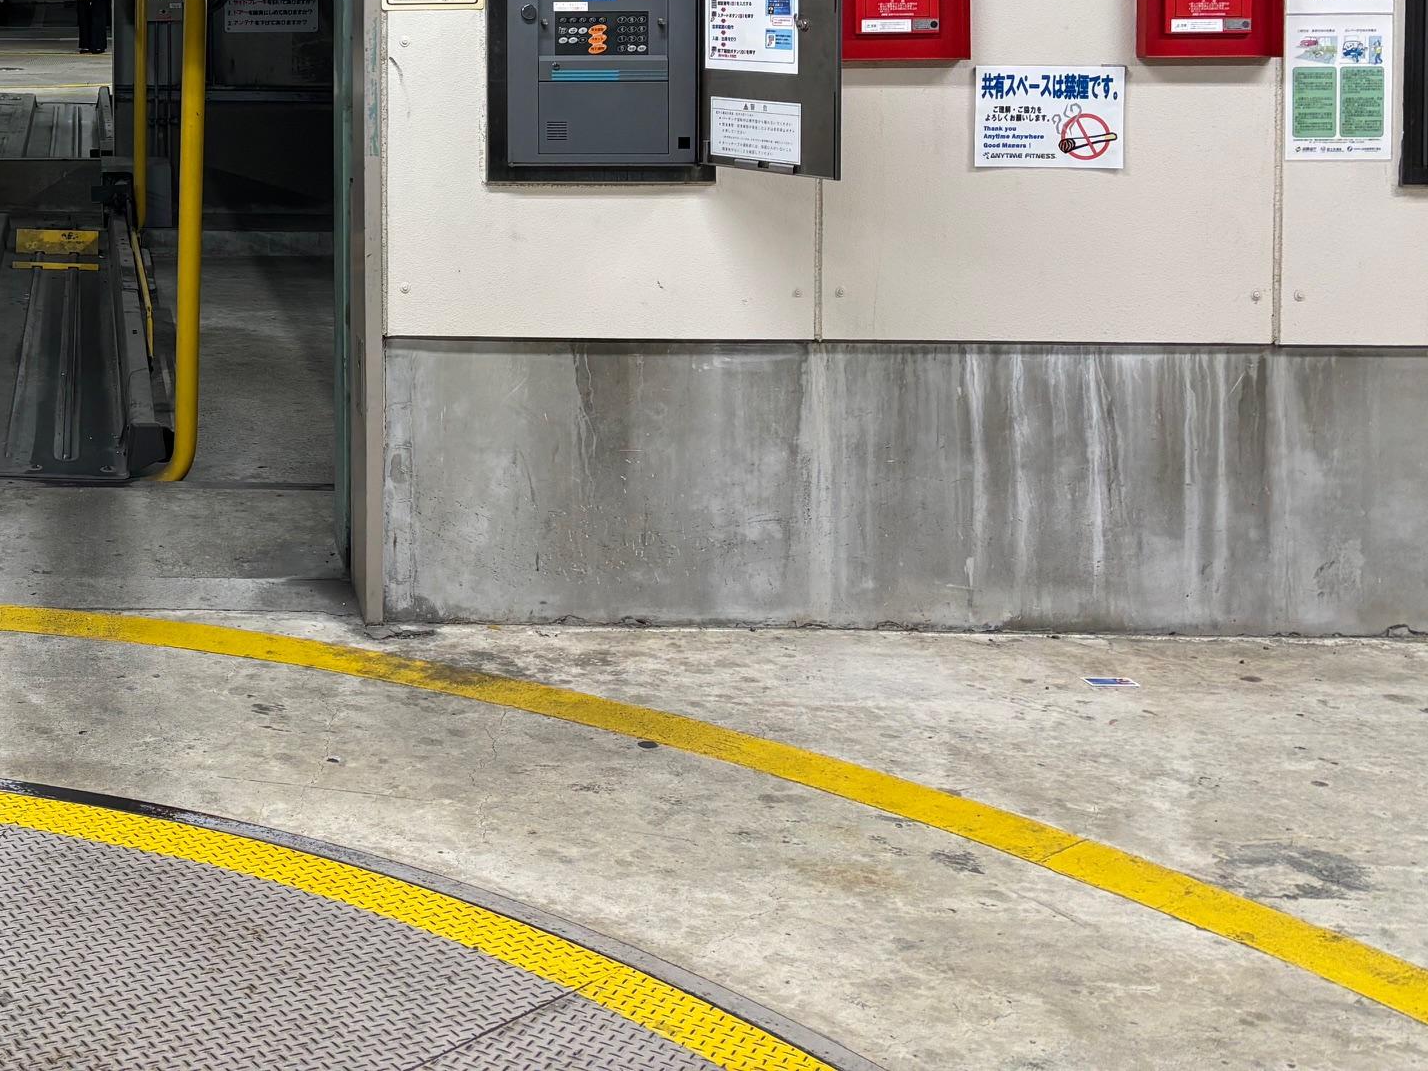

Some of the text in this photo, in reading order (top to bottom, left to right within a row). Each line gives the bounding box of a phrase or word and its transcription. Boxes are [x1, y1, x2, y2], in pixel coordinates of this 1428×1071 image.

[981, 72, 1118, 100] 共有スペースは禁煙です。
[984, 114, 1050, 123] よろしくお願いします。
[983, 133, 1045, 141] Anytime Anywhere
